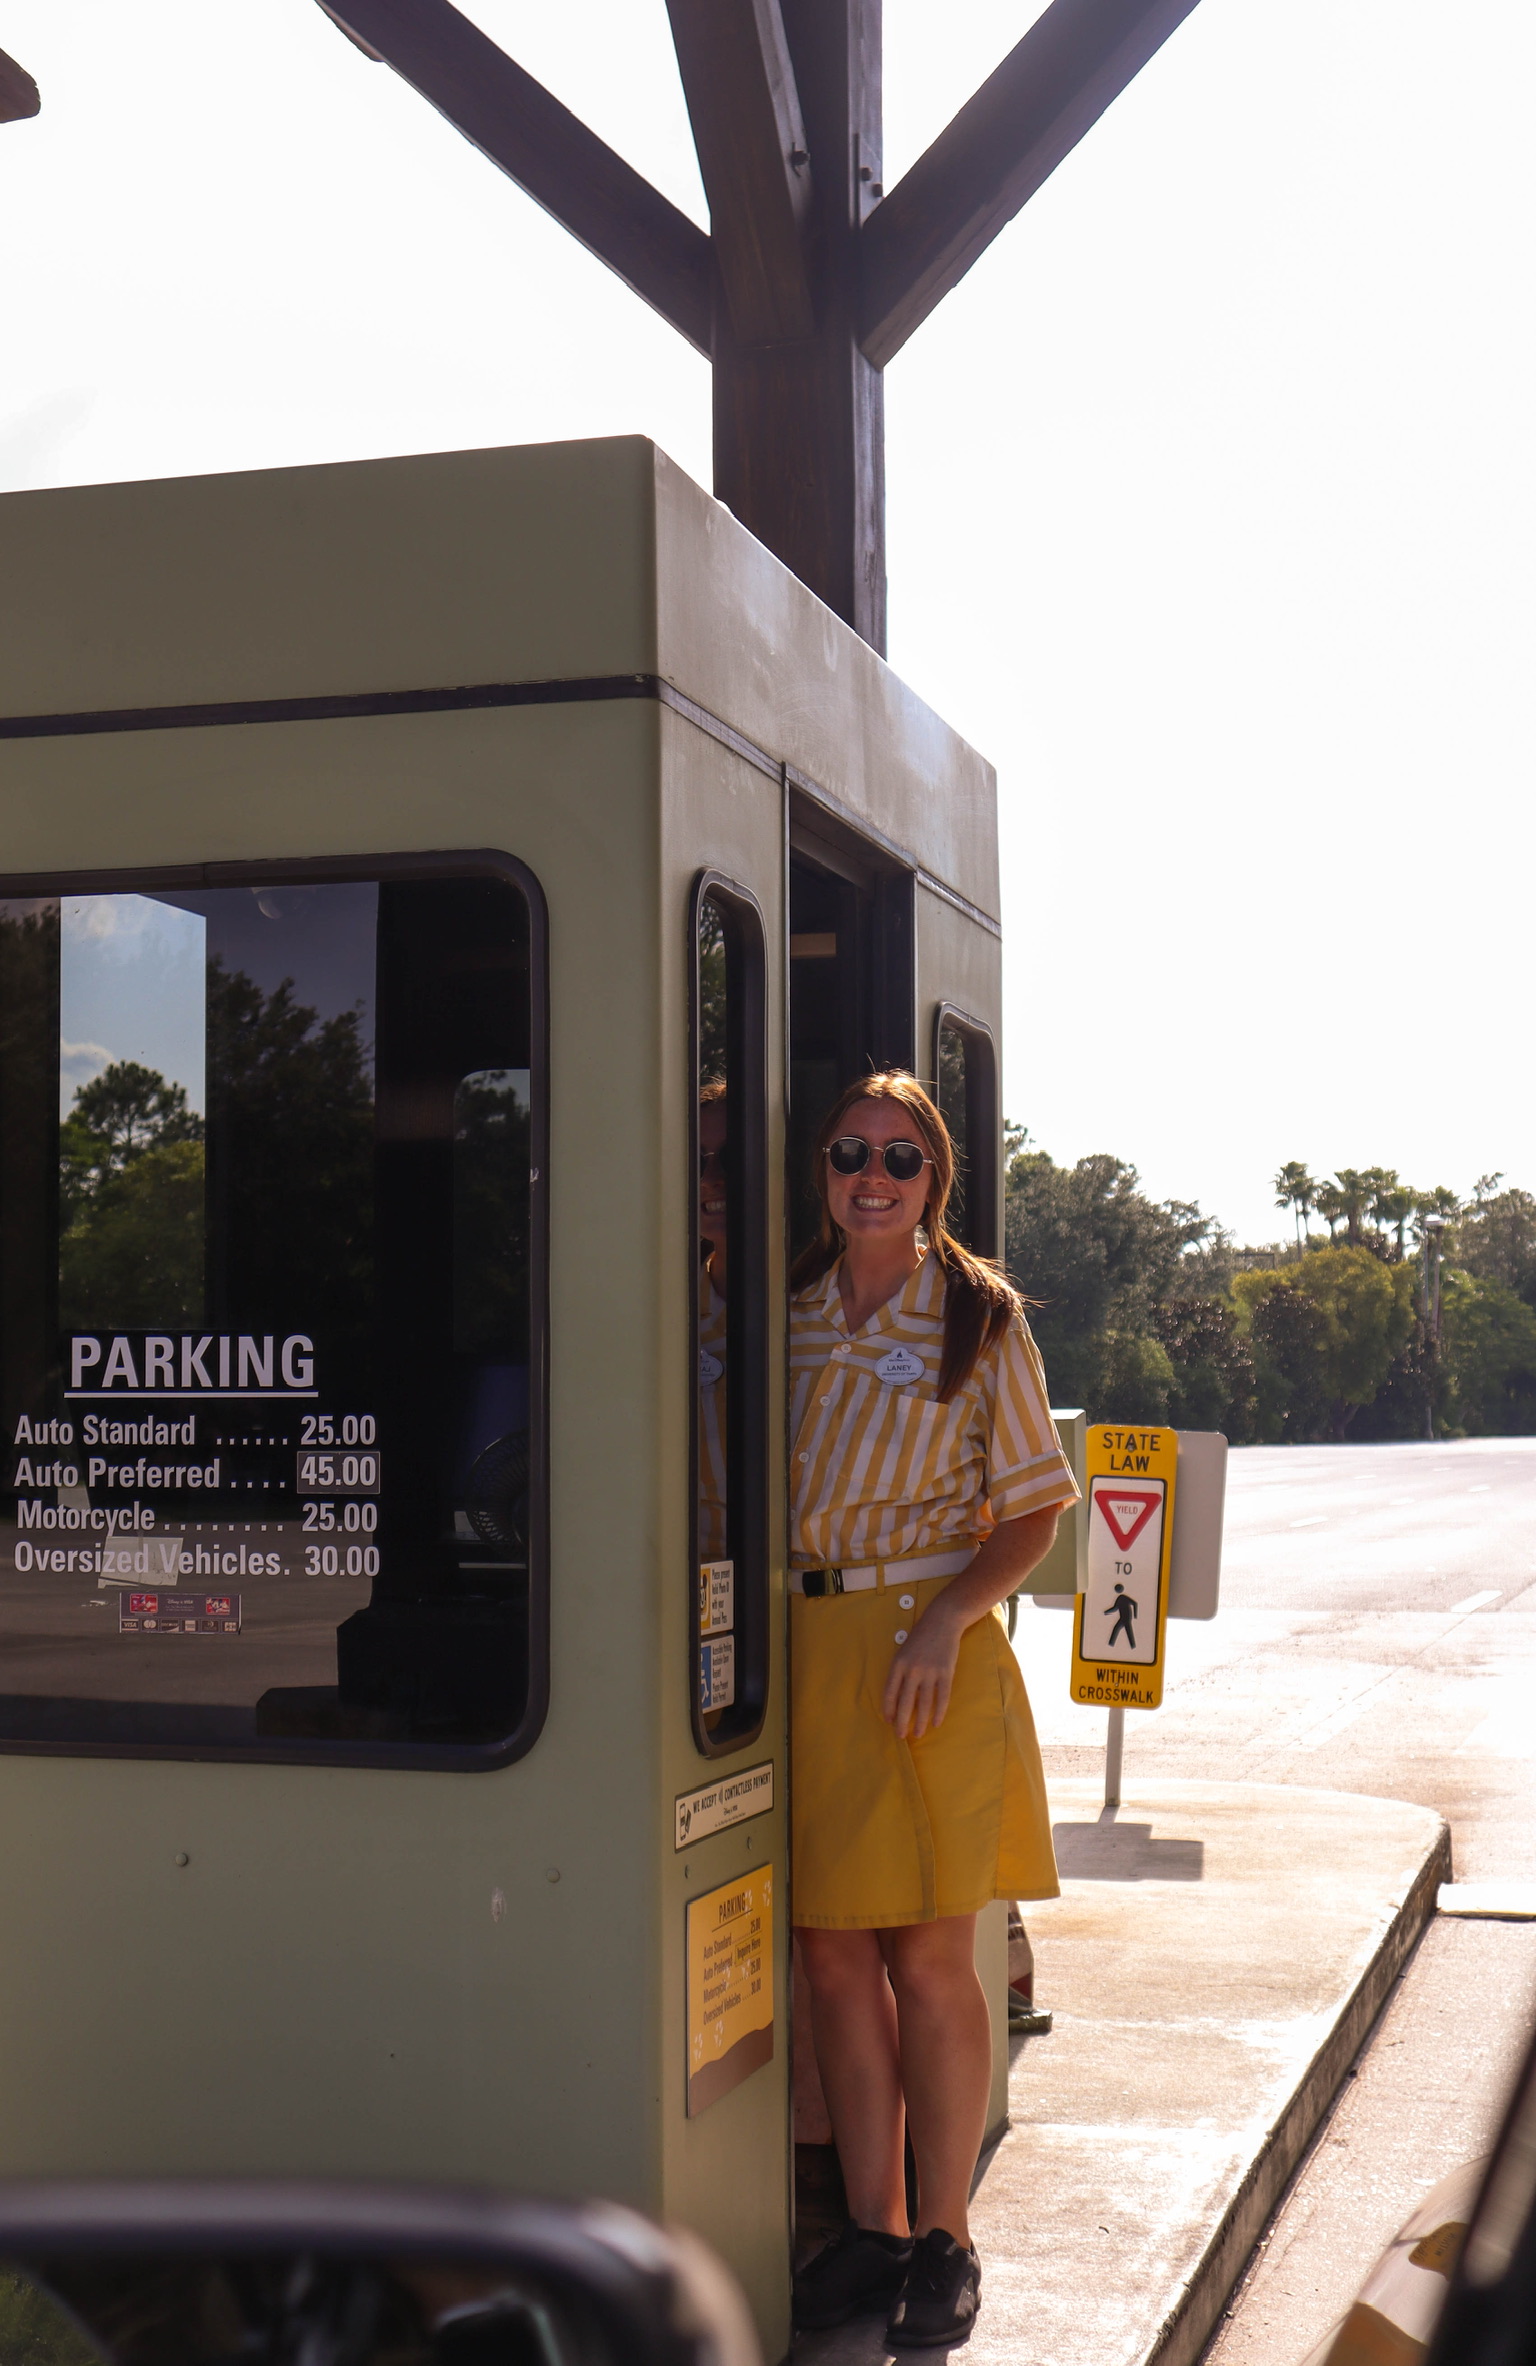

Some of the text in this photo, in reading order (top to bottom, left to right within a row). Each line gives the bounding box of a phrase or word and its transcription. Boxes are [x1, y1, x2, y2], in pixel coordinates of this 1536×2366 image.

[71, 1335, 315, 1388] PARKING
[14, 1415, 376, 1445] Auto Standard 25.00
[1103, 1432, 1161, 1452] STATE
[14, 1456, 376, 1488] Auto Preferred 45.00
[1110, 1454, 1150, 1472] LAW
[17, 1500, 378, 1536] Motorcycle 25.00
[1116, 1505, 1138, 1515] YIELD
[14, 1541, 149, 1573] Oversized
[304, 1545, 380, 1576] 30.00
[1115, 1562, 1132, 1575] TO
[1096, 1668, 1139, 1685] WITHIN
[1078, 1685, 1153, 1704] CROSSWALK
[693, 1800, 700, 1814] WE
[701, 1793, 717, 1810] ACCEPT
[724, 1779, 752, 1801] CONTACTLESS
[753, 1772, 771, 1790] PAYMENT
[719, 1892, 746, 1923] PARKING
[703, 1946, 713, 1960] Auto
[714, 1932, 732, 1955] Standard
[703, 1967, 713, 1982] Auto
[751, 1937, 761, 1953] Here
[724, 1993, 741, 2014] Vehicles
